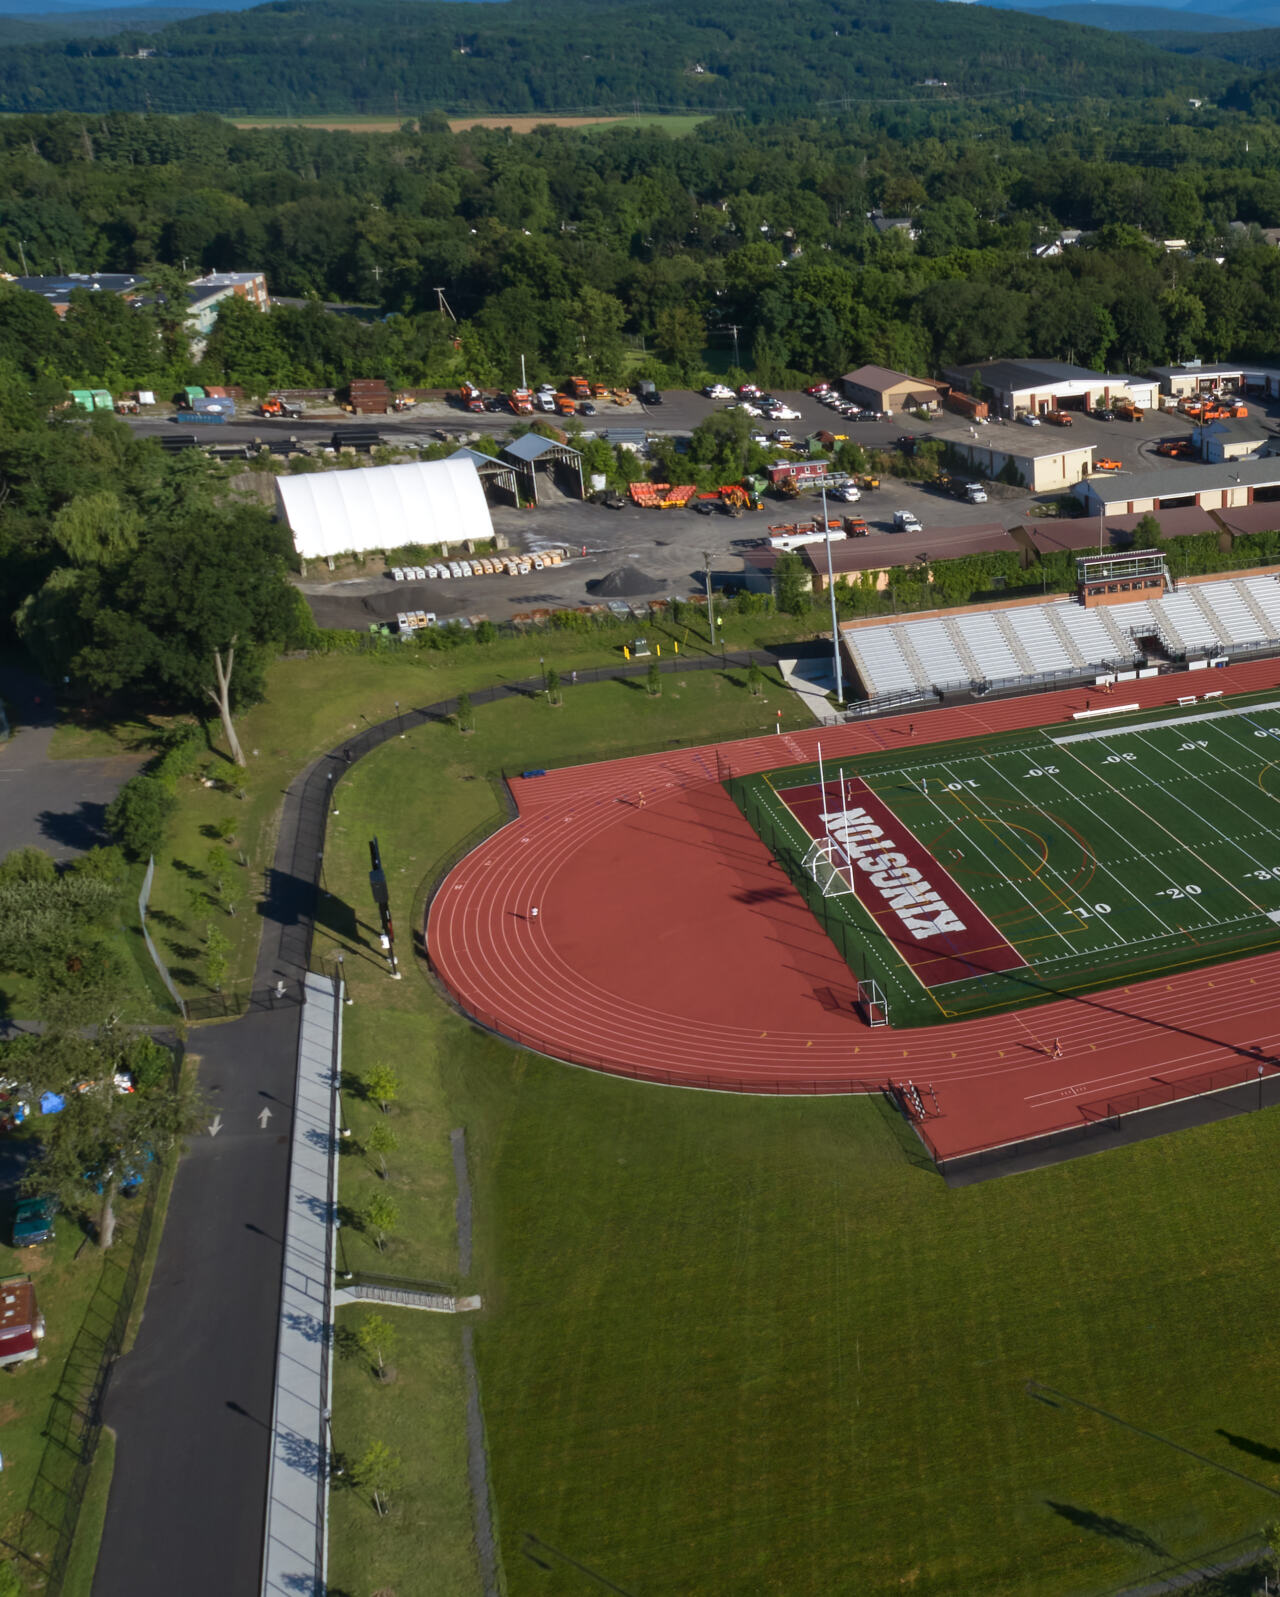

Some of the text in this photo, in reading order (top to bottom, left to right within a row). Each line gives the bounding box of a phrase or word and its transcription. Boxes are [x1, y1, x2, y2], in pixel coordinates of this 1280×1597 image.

[1181, 740, 1209, 750] 40
[1106, 752, 1138, 764] 30
[1028, 765, 1060, 778] 20
[948, 779, 981, 792] 10
[818, 807, 968, 940] KINGSTON
[1166, 884, 1202, 899] 20
[1073, 903, 1112, 919] 10
